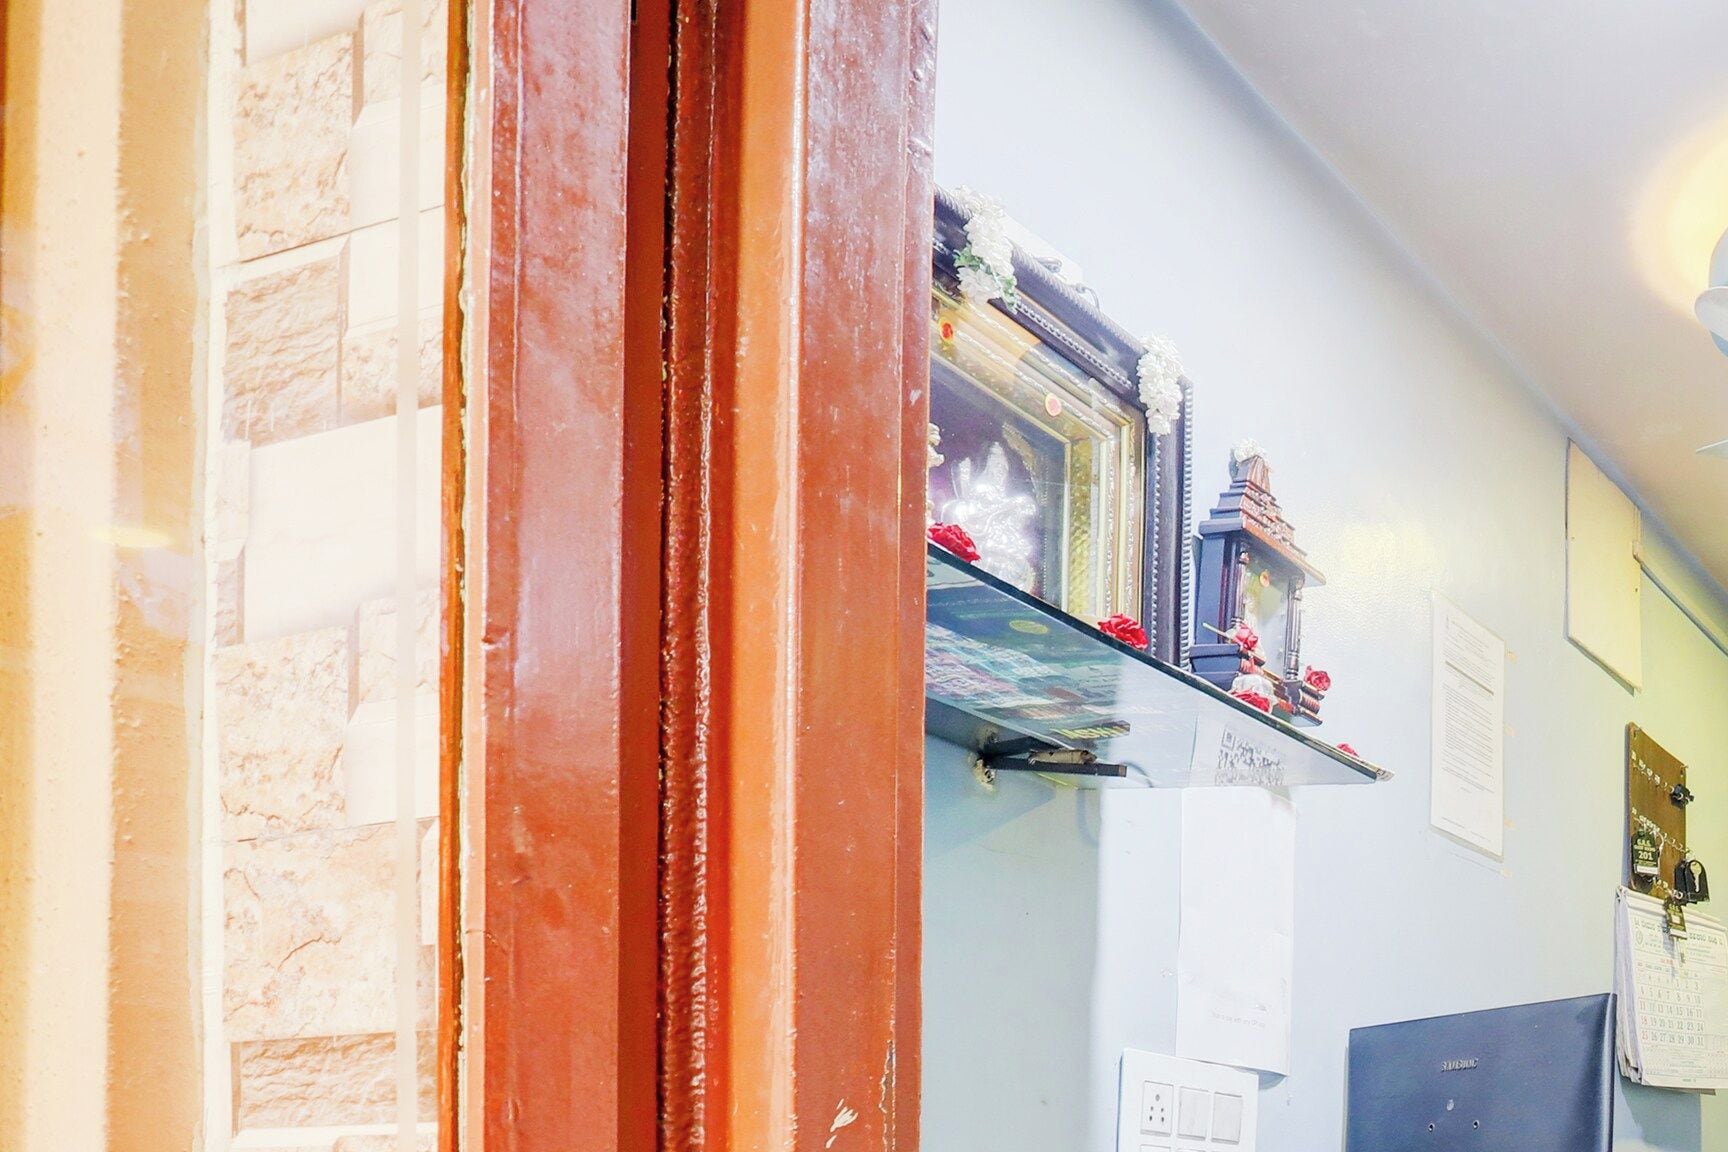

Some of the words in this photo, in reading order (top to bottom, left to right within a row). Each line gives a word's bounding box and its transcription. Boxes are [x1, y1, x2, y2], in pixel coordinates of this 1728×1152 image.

[1638, 850, 1653, 860] 201
[1640, 1001, 1646, 1011] 11
[1676, 1006, 1683, 1016] 15
[1687, 1007, 1693, 1017] 16
[1677, 1020, 1683, 1030] 22
[1687, 1021, 1694, 1031] 23
[1697, 1022, 1703, 1032] 24
[1642, 1029, 1648, 1040] 25
[1651, 1031, 1657, 1041] 26
[1659, 1032, 1666, 1042] 27
[1668, 1033, 1675, 1043] 28
[1677, 1034, 1684, 1044] 29
[1687, 1035, 1694, 1046] 30
[1697, 1036, 1703, 1046] 31
[1441, 1058, 1479, 1072] SAMSUNG
